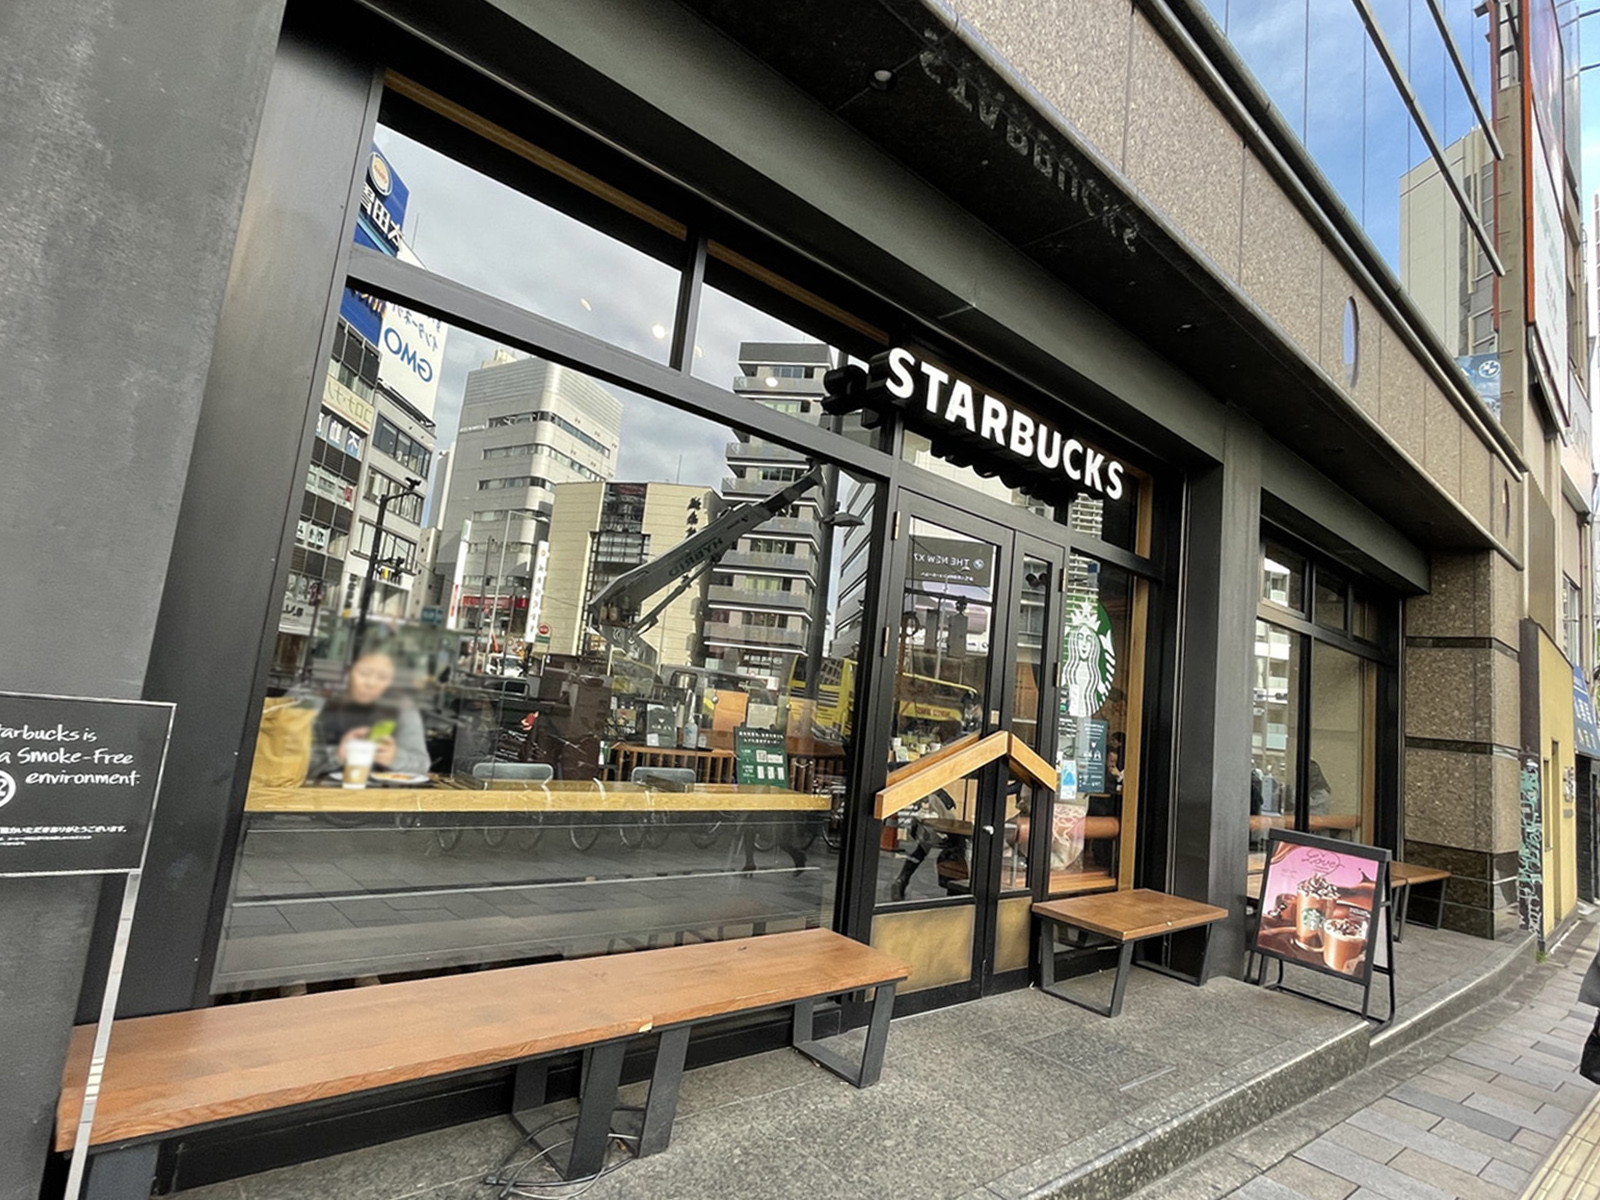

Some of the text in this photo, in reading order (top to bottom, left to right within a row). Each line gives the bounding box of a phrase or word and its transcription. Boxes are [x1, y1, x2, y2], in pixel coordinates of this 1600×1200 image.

[885, 346, 1125, 501] STARBUCKS
[83, 729, 97, 742] is
[0, 747, 134, 764] a Smoke-Free
